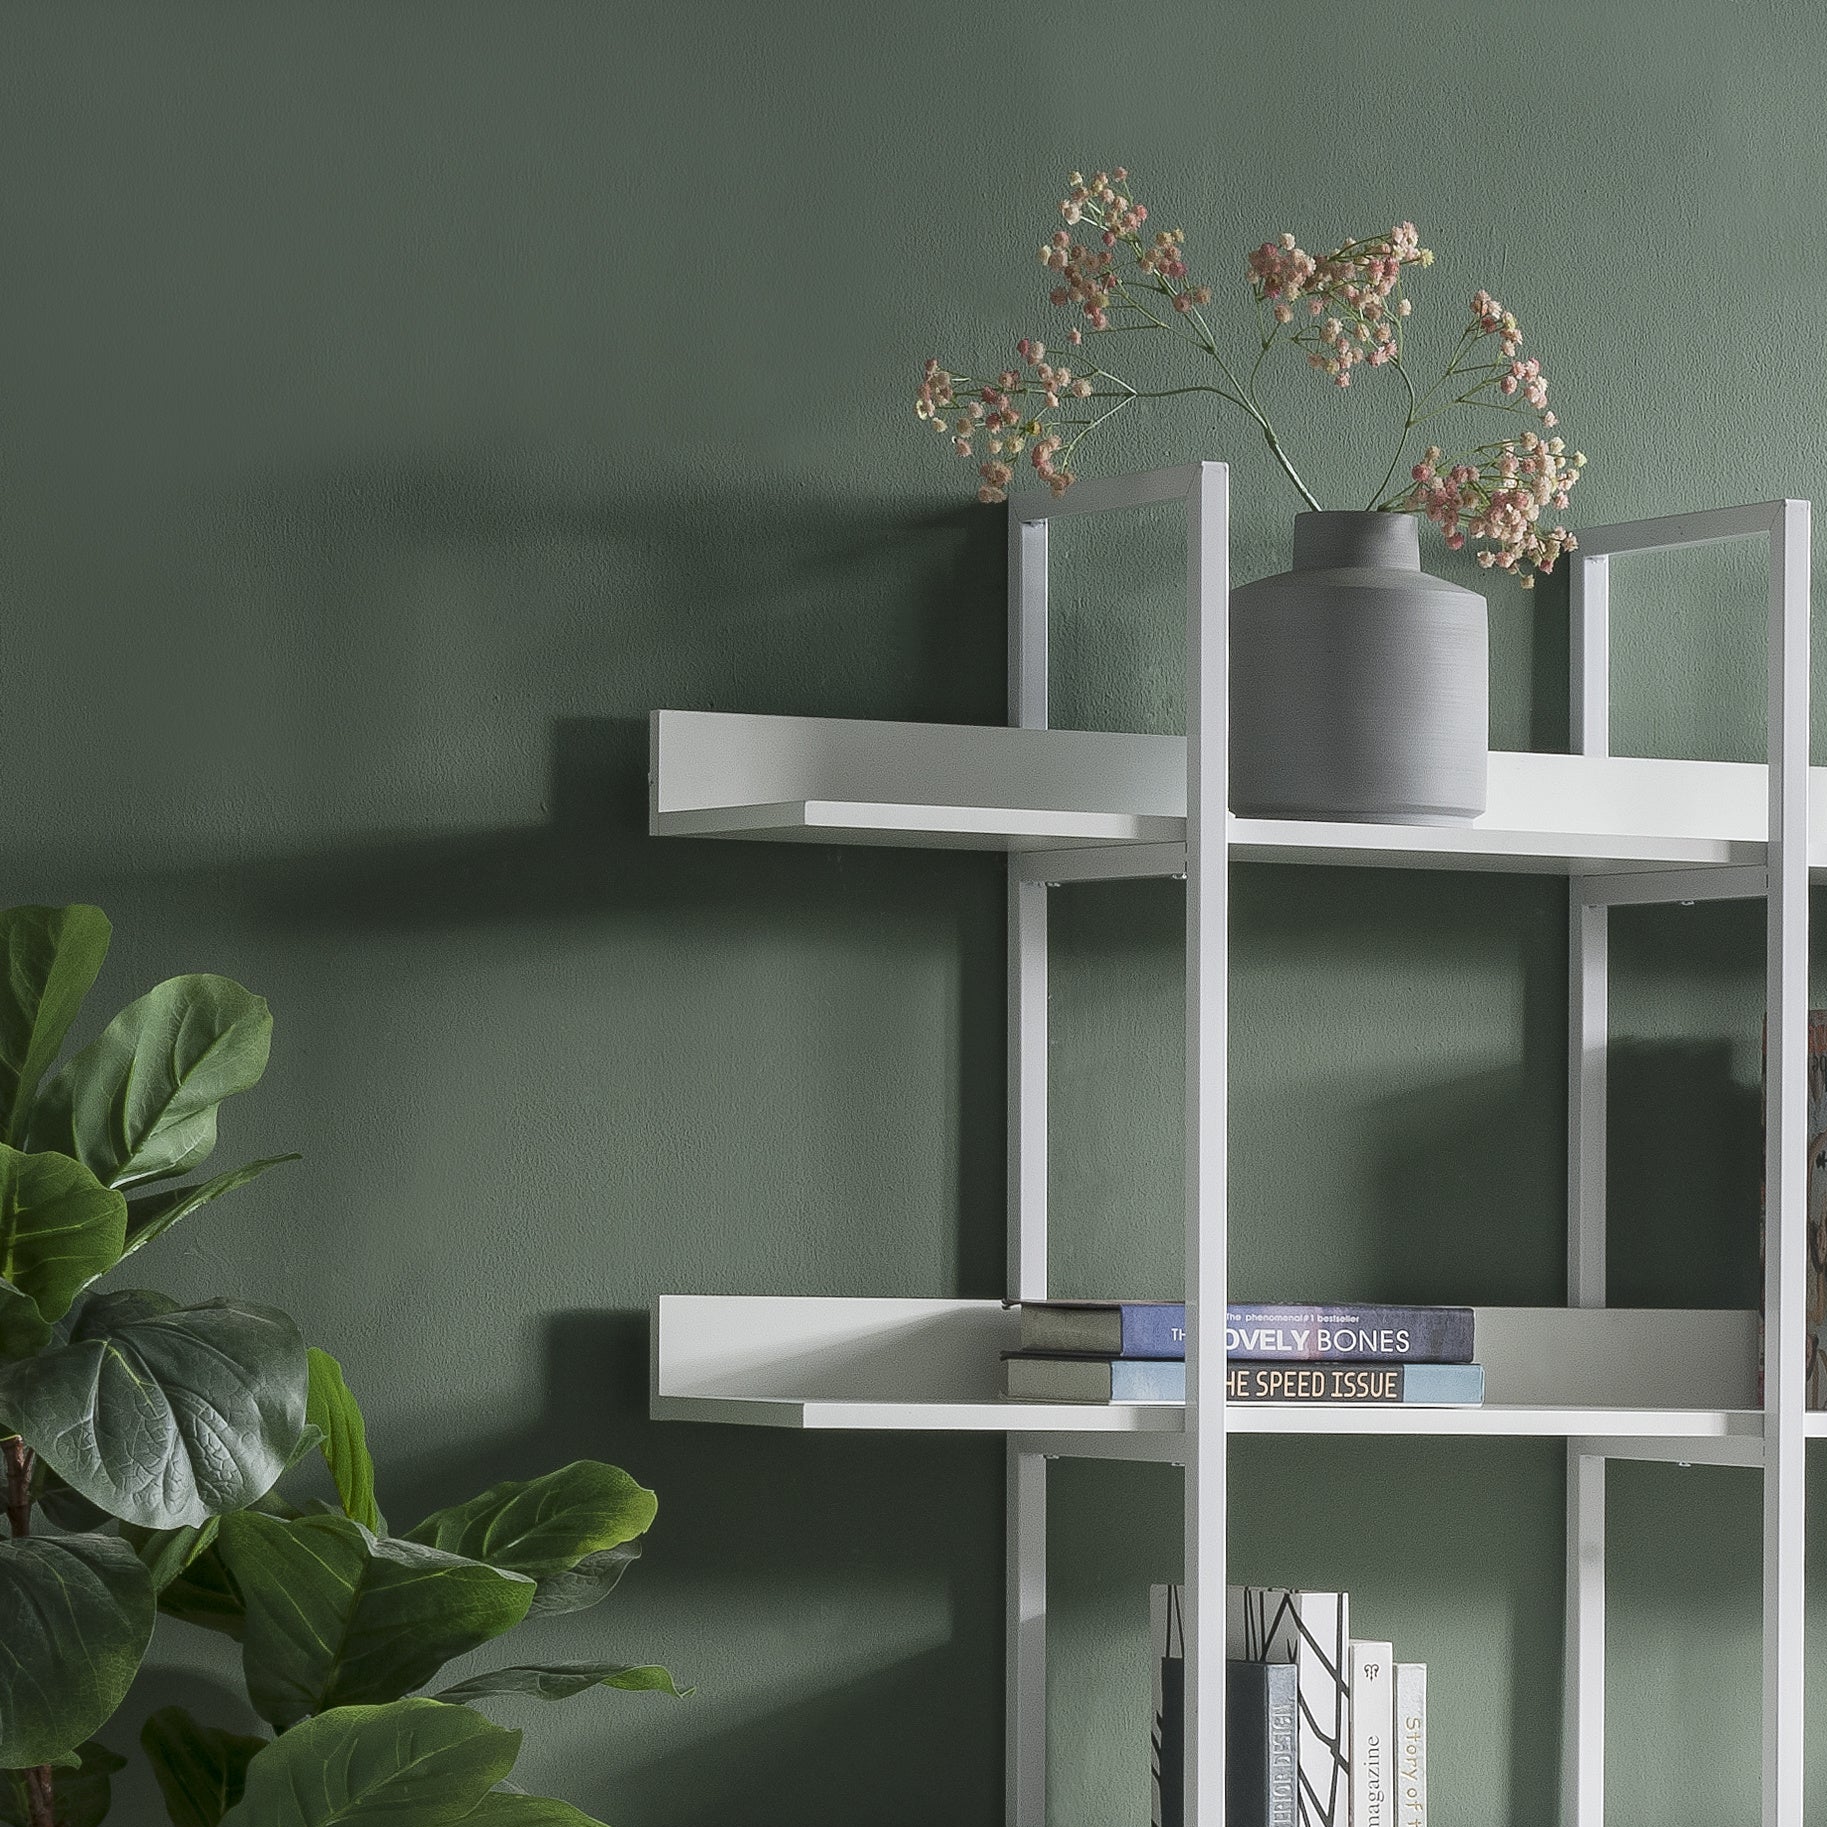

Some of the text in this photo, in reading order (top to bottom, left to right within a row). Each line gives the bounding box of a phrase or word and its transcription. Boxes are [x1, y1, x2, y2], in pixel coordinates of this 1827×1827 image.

[1317, 1314, 1359, 1323] bestseller
[1171, 1328, 1410, 1352] TH OVELY BONES
[1227, 1371, 1398, 1398] HE SPEED ISSUE
[1400, 1717, 1421, 1781] Story
[1406, 1786, 1423, 1811] of
